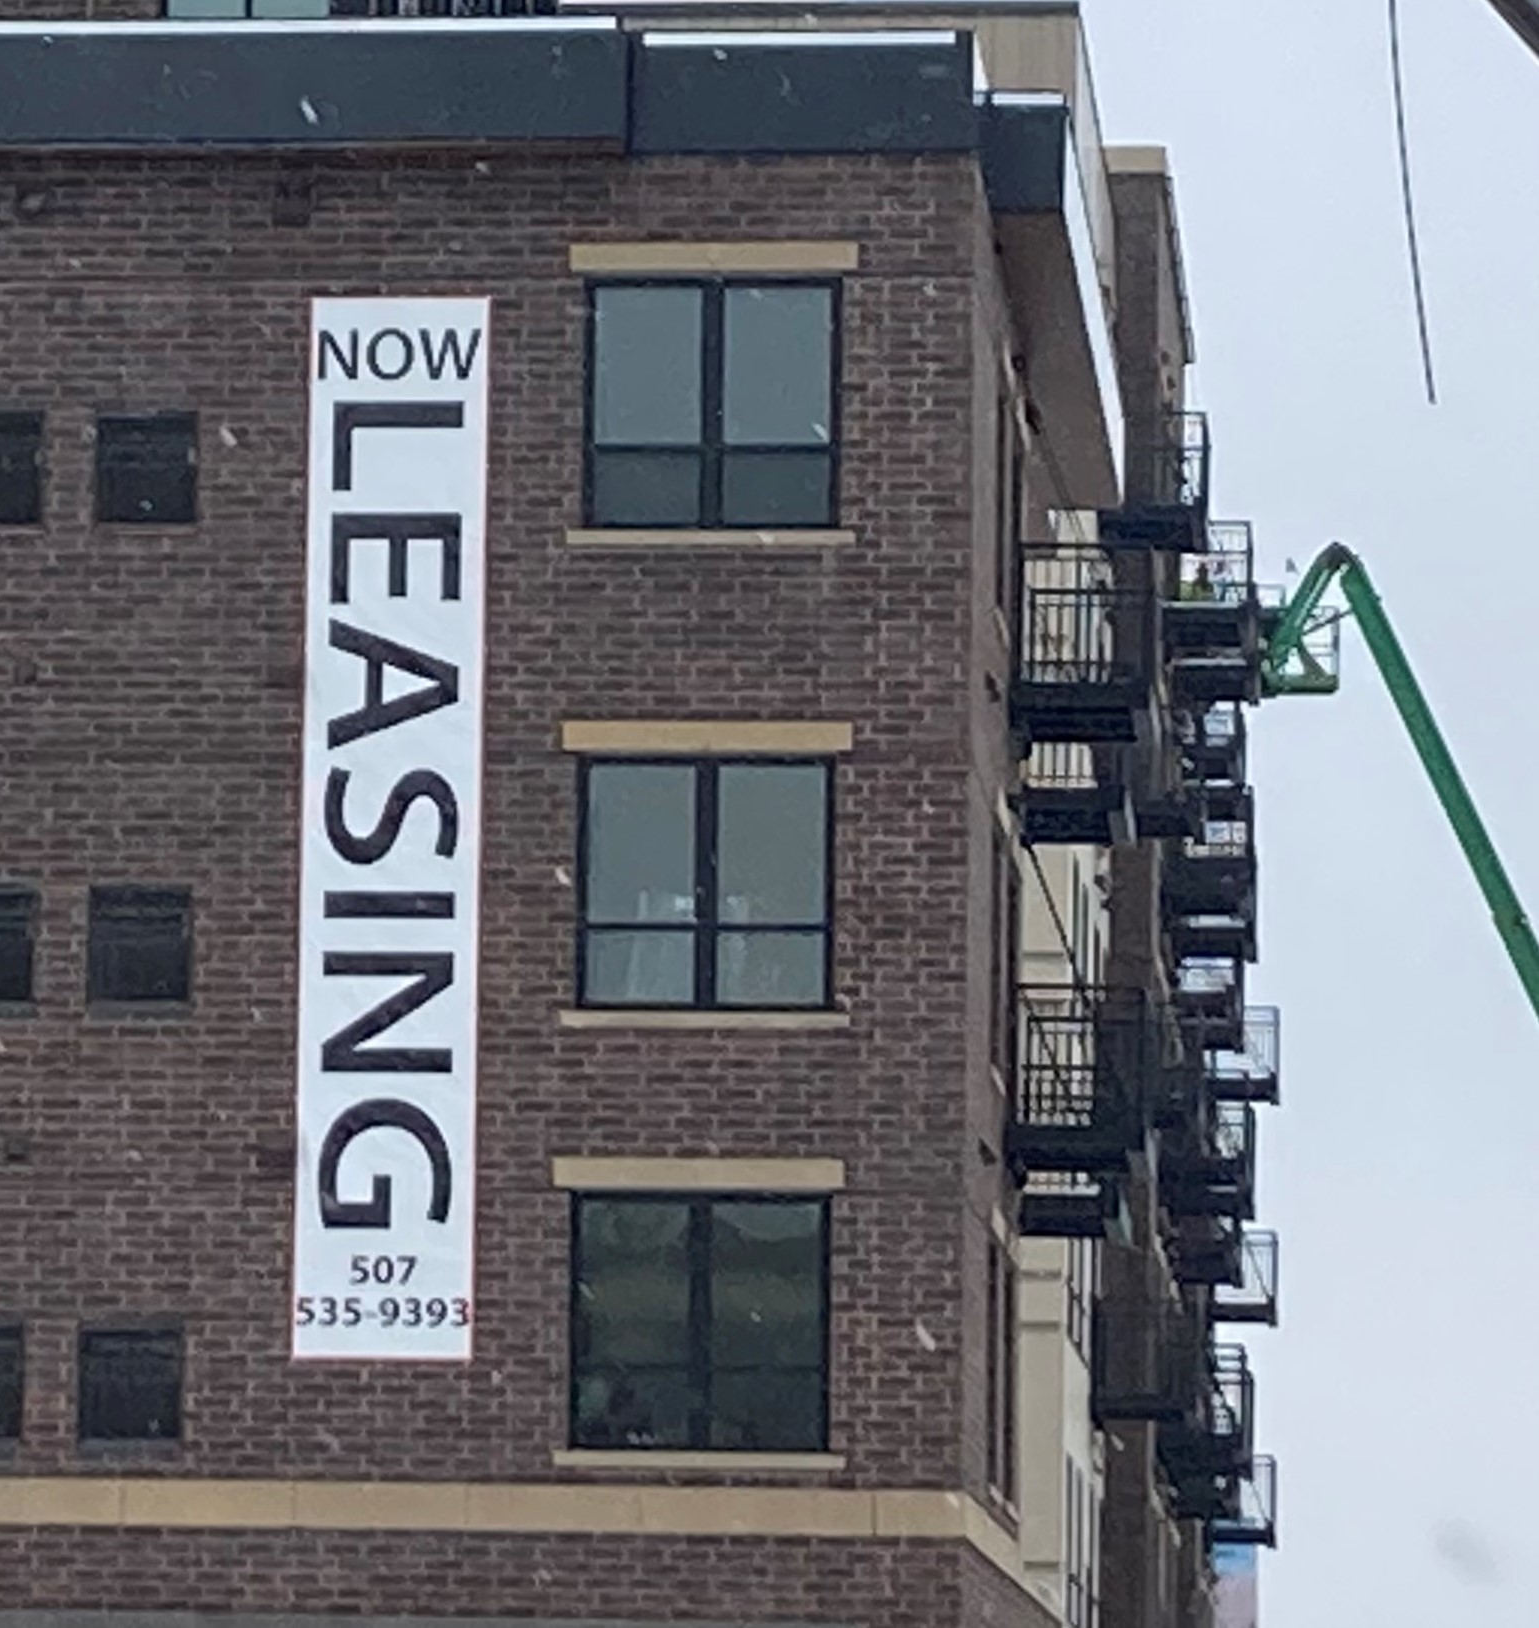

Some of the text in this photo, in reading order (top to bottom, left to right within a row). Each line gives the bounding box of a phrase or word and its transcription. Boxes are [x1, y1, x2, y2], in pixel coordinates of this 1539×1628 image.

[317, 328, 482, 380] NOW
[318, 400, 464, 1230] LEASING
[350, 1255, 418, 1285] 507
[296, 1297, 470, 1327] 535-9393
